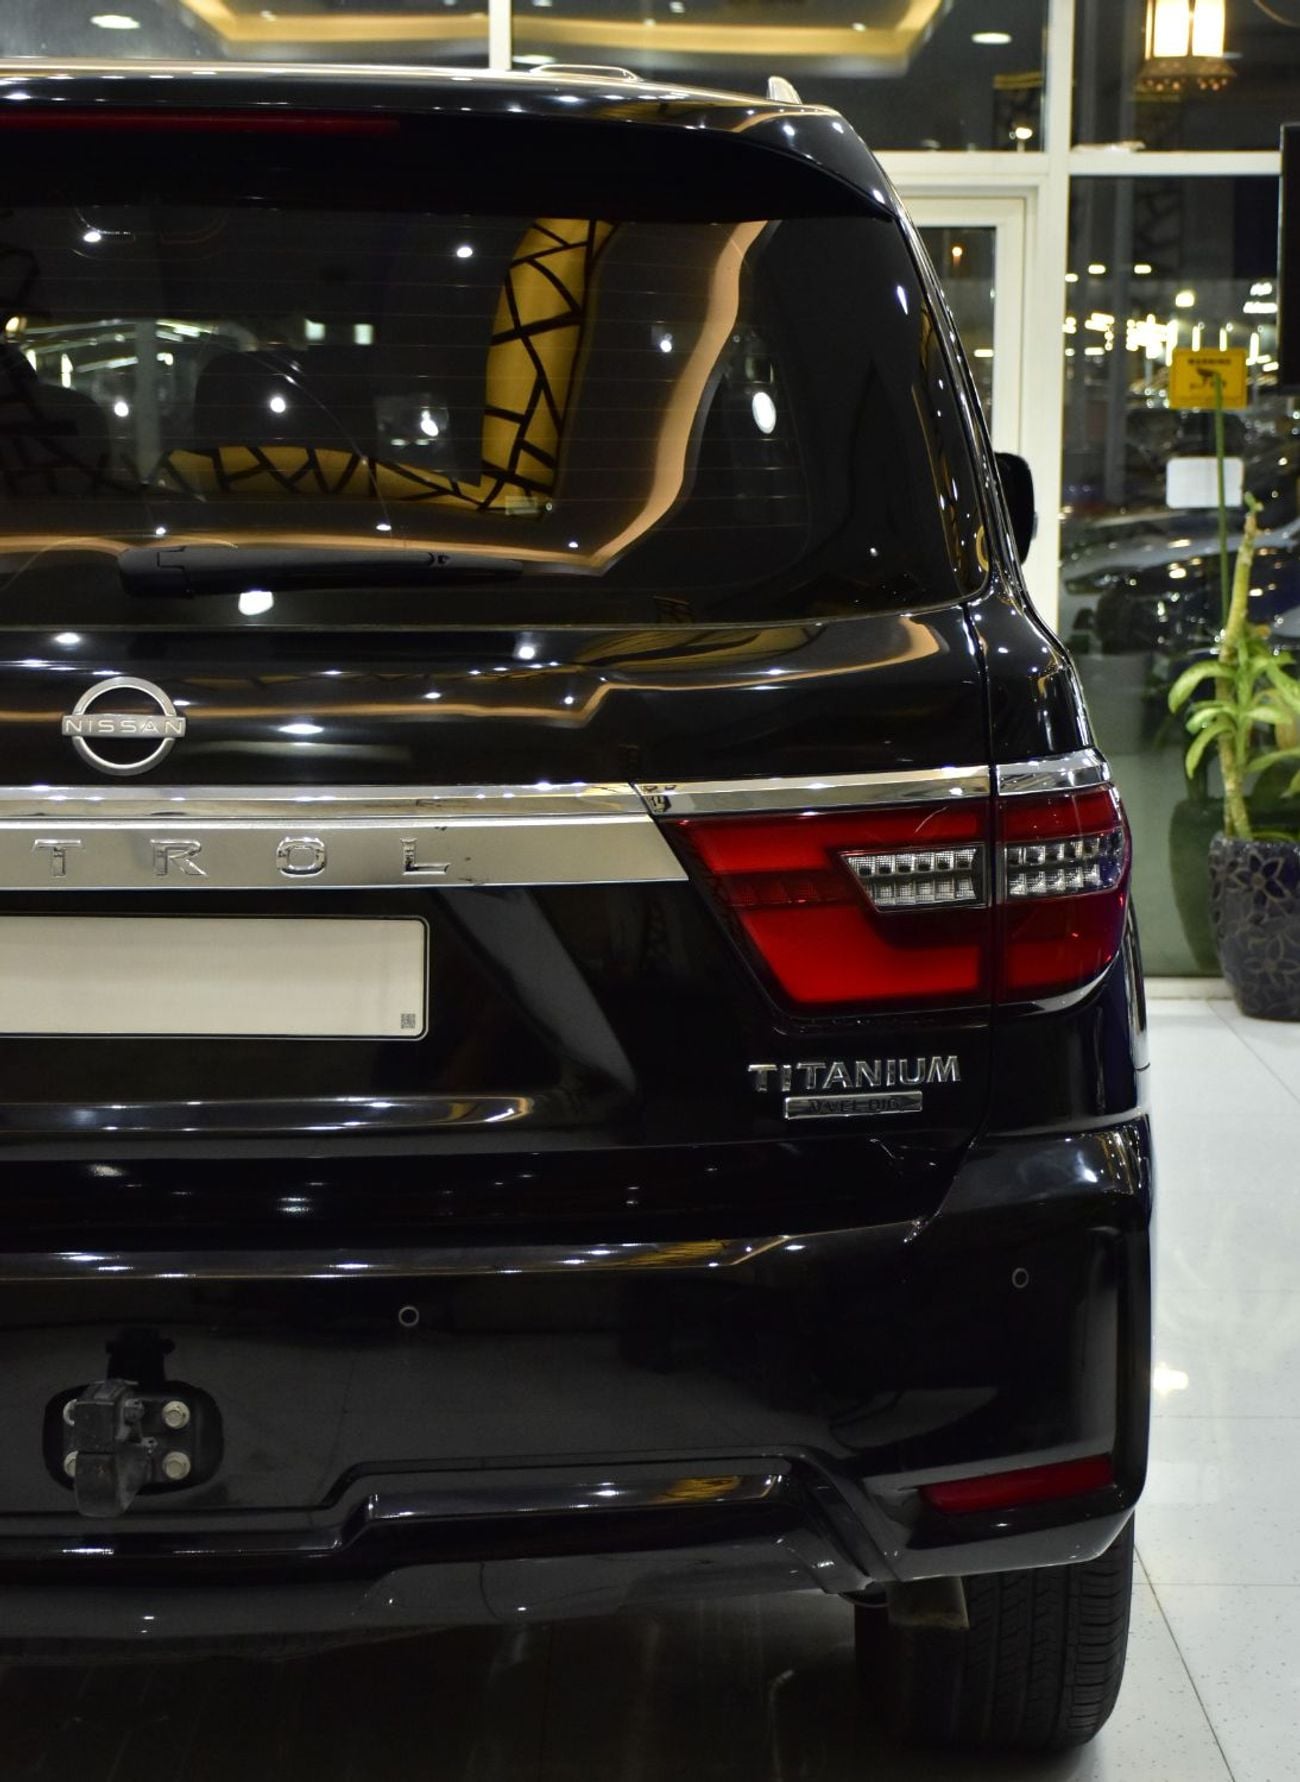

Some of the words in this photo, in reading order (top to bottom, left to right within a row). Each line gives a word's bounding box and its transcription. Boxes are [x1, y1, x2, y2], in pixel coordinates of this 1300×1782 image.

[65, 719, 183, 735] NISSAN
[32, 837, 451, 878] TROL
[748, 1055, 961, 1092] TITANIUM
